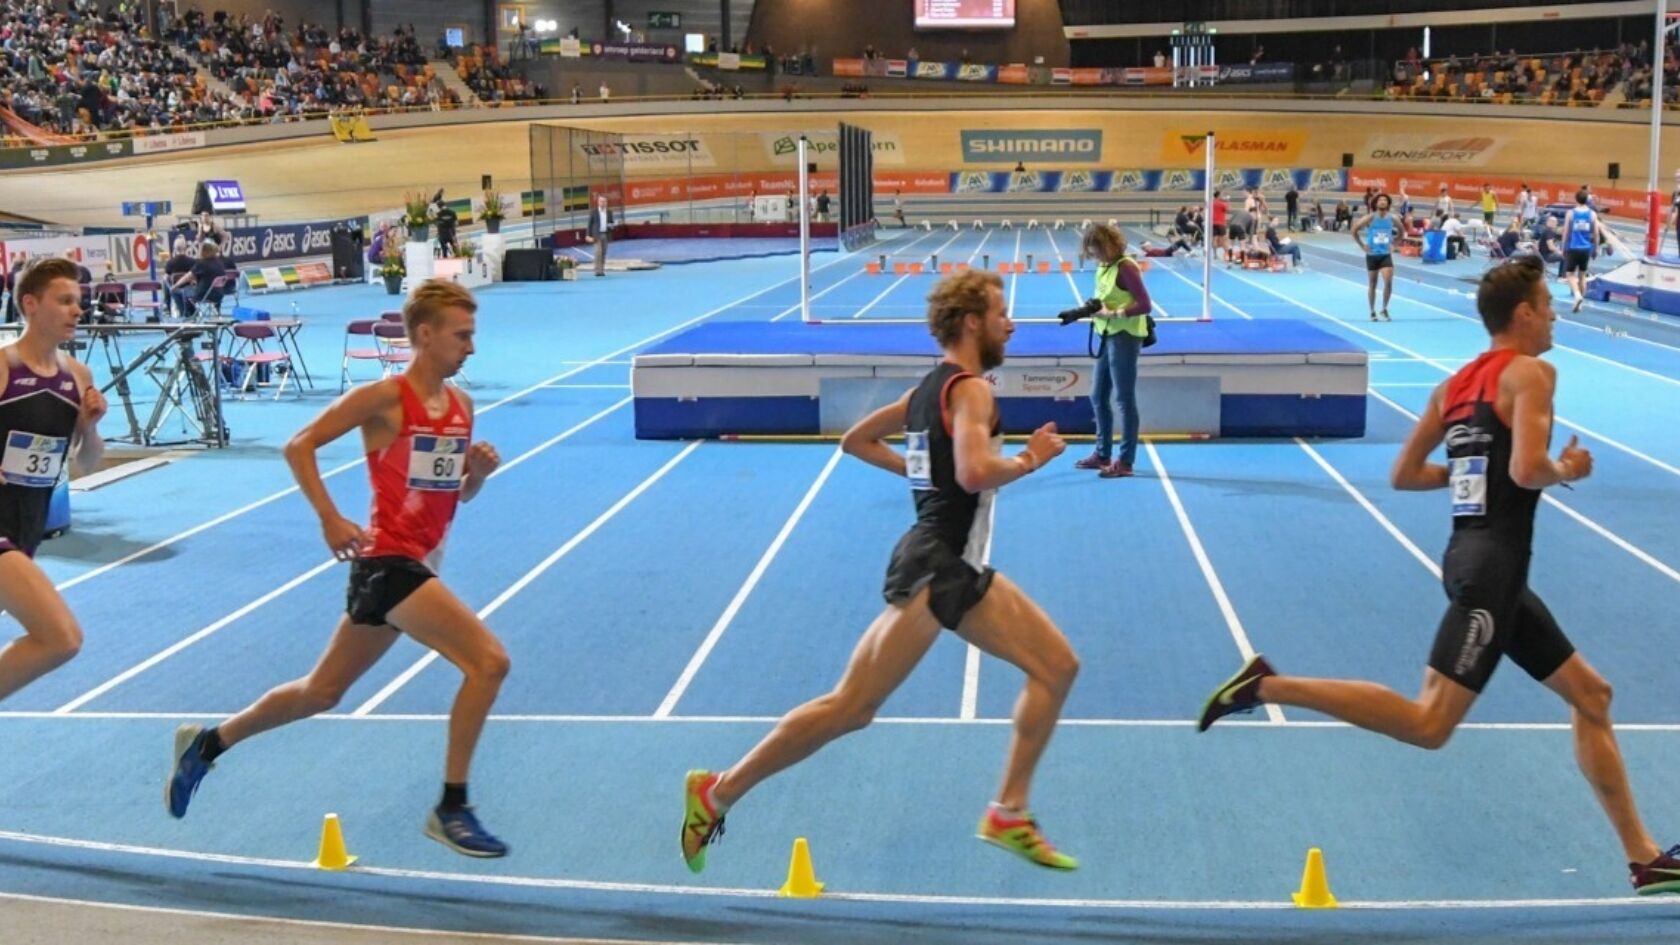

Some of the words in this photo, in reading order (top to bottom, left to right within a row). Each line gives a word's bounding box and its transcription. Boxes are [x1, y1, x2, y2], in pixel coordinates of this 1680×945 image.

[613, 140, 700, 154] TISSOT
[969, 138, 1095, 153] SHIMANO
[1371, 149, 1480, 160] OMNISPORT
[232, 235, 256, 257] asics
[273, 231, 296, 252] asics
[311, 228, 332, 249] asics
[26, 454, 51, 474] 33
[433, 457, 455, 477] 60
